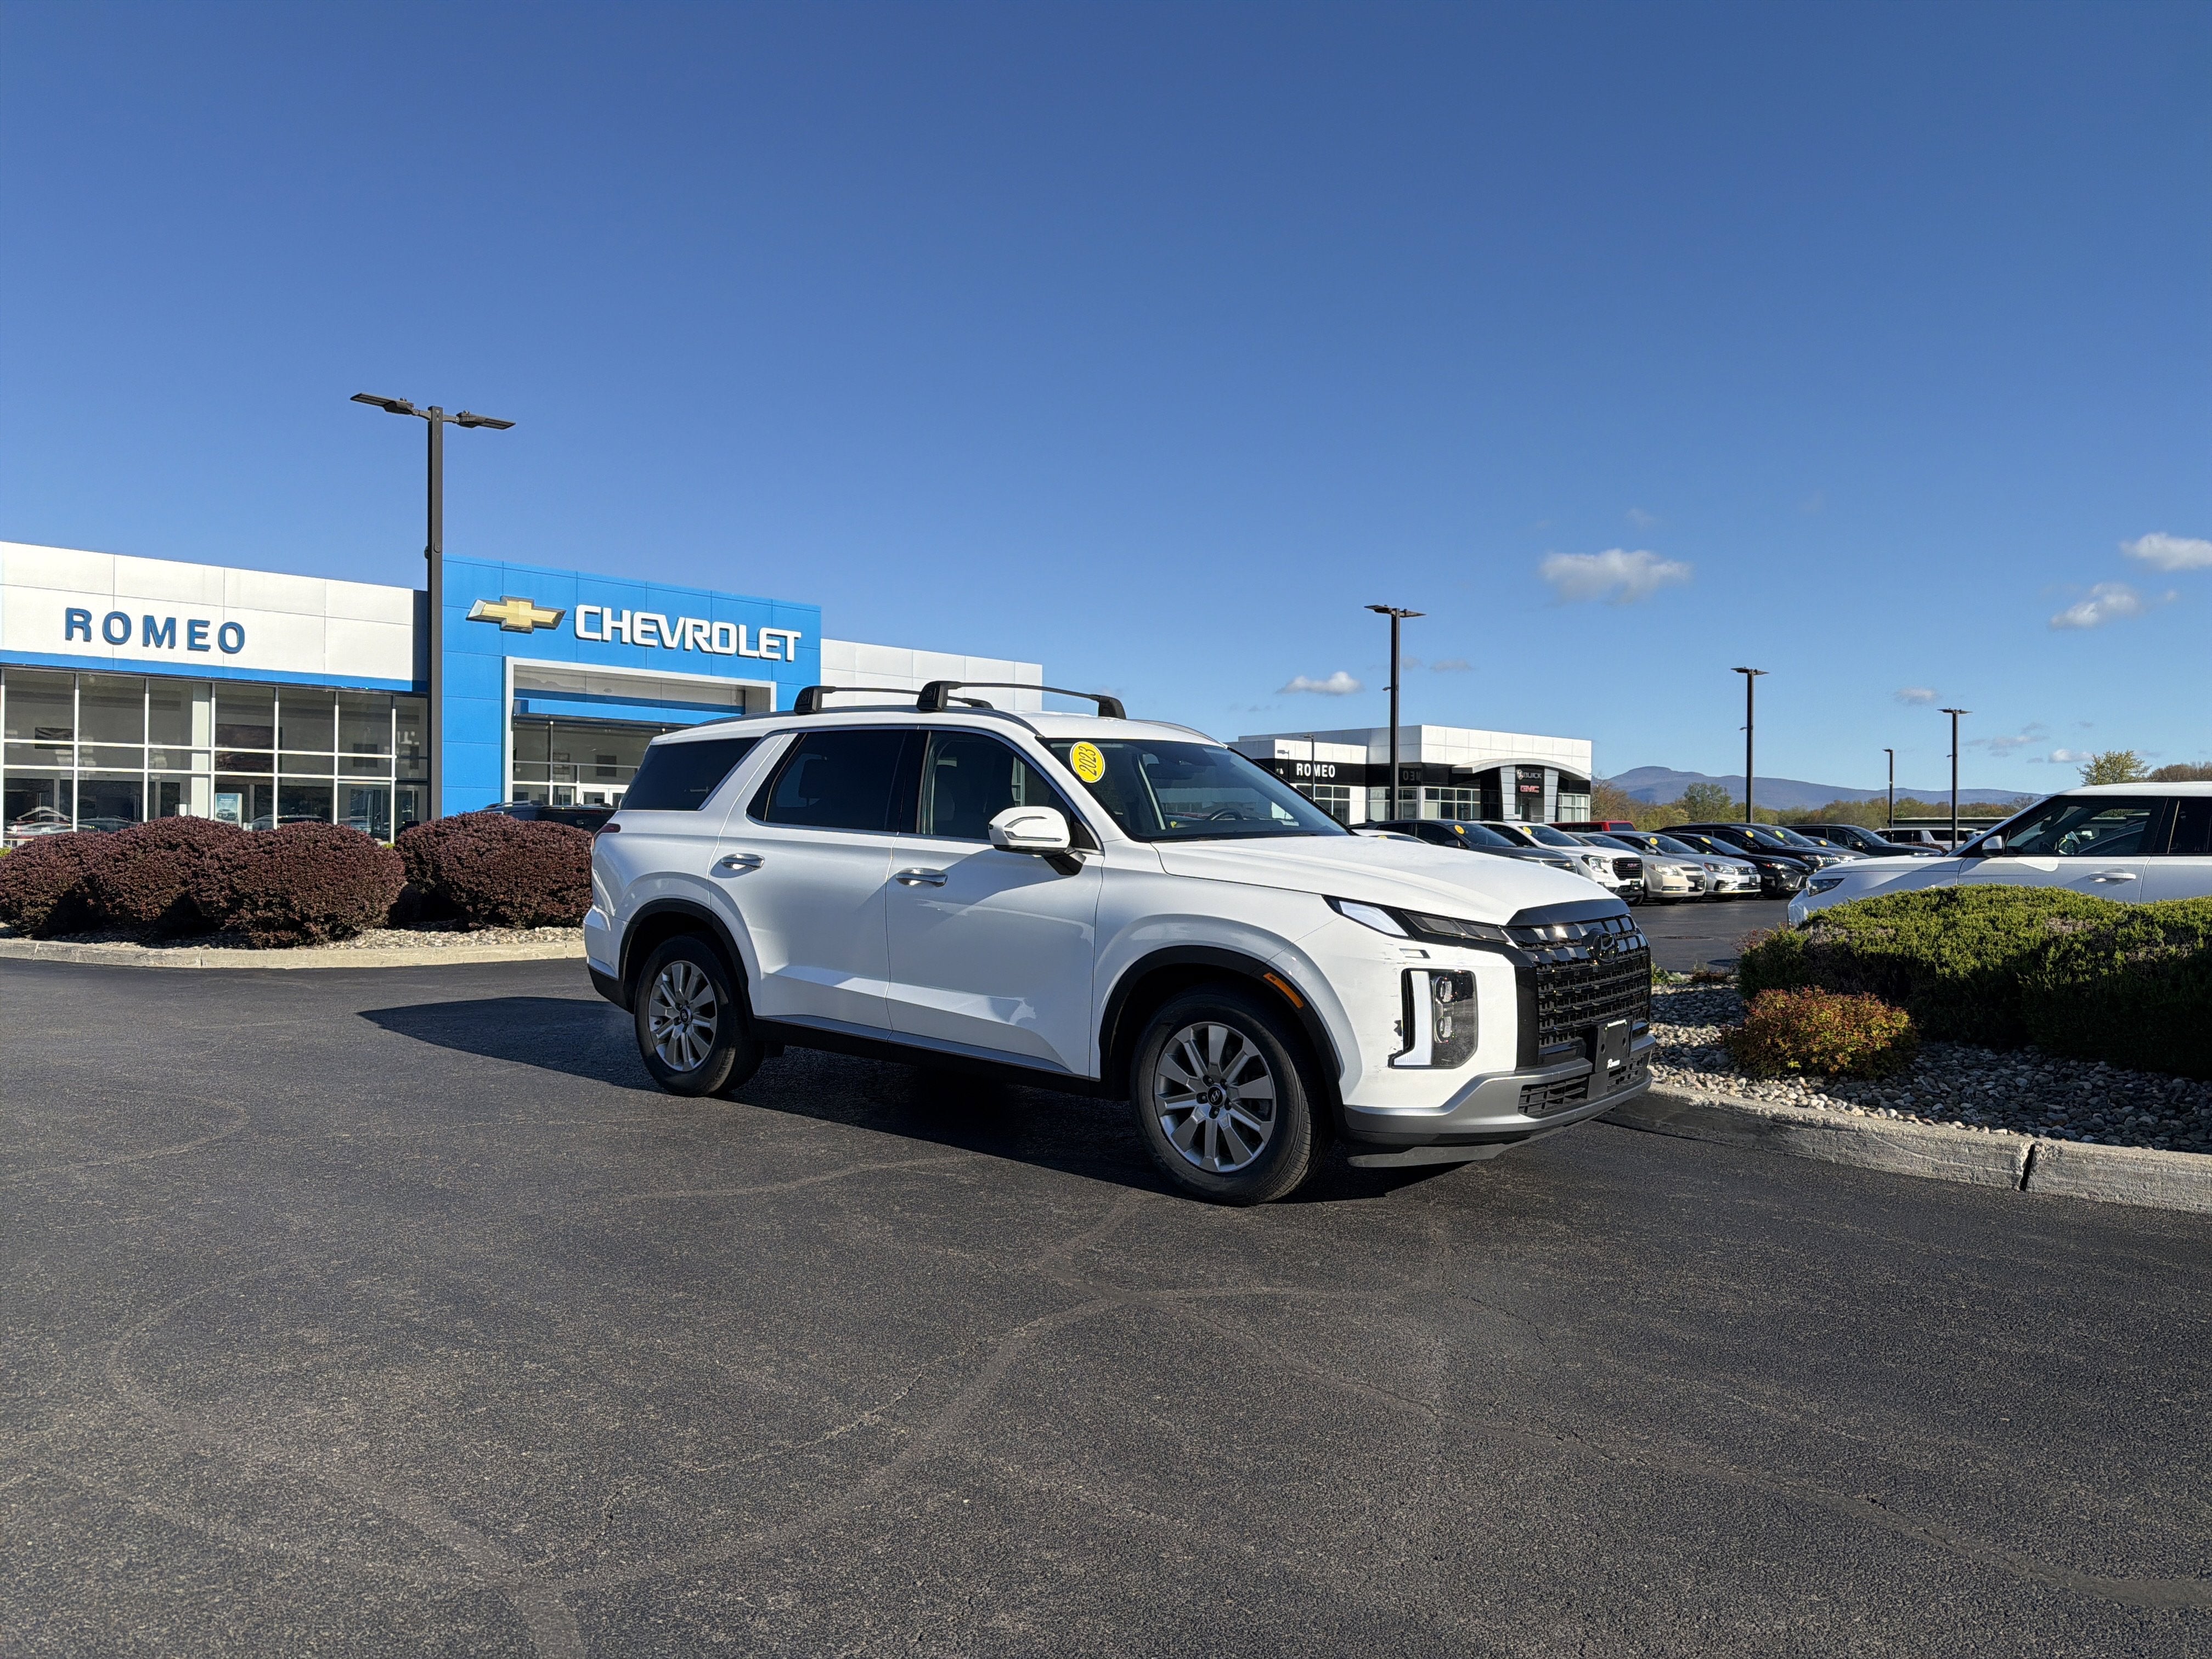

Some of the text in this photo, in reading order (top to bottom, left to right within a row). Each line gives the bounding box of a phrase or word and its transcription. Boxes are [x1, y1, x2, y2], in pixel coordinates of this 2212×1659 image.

[65, 607, 245, 654] ROMEO
[574, 604, 802, 662] CHEVROLET
[1079, 746, 1097, 776] 2023
[1296, 763, 1335, 777] ROMEO
[1520, 785, 1539, 793] GMC
